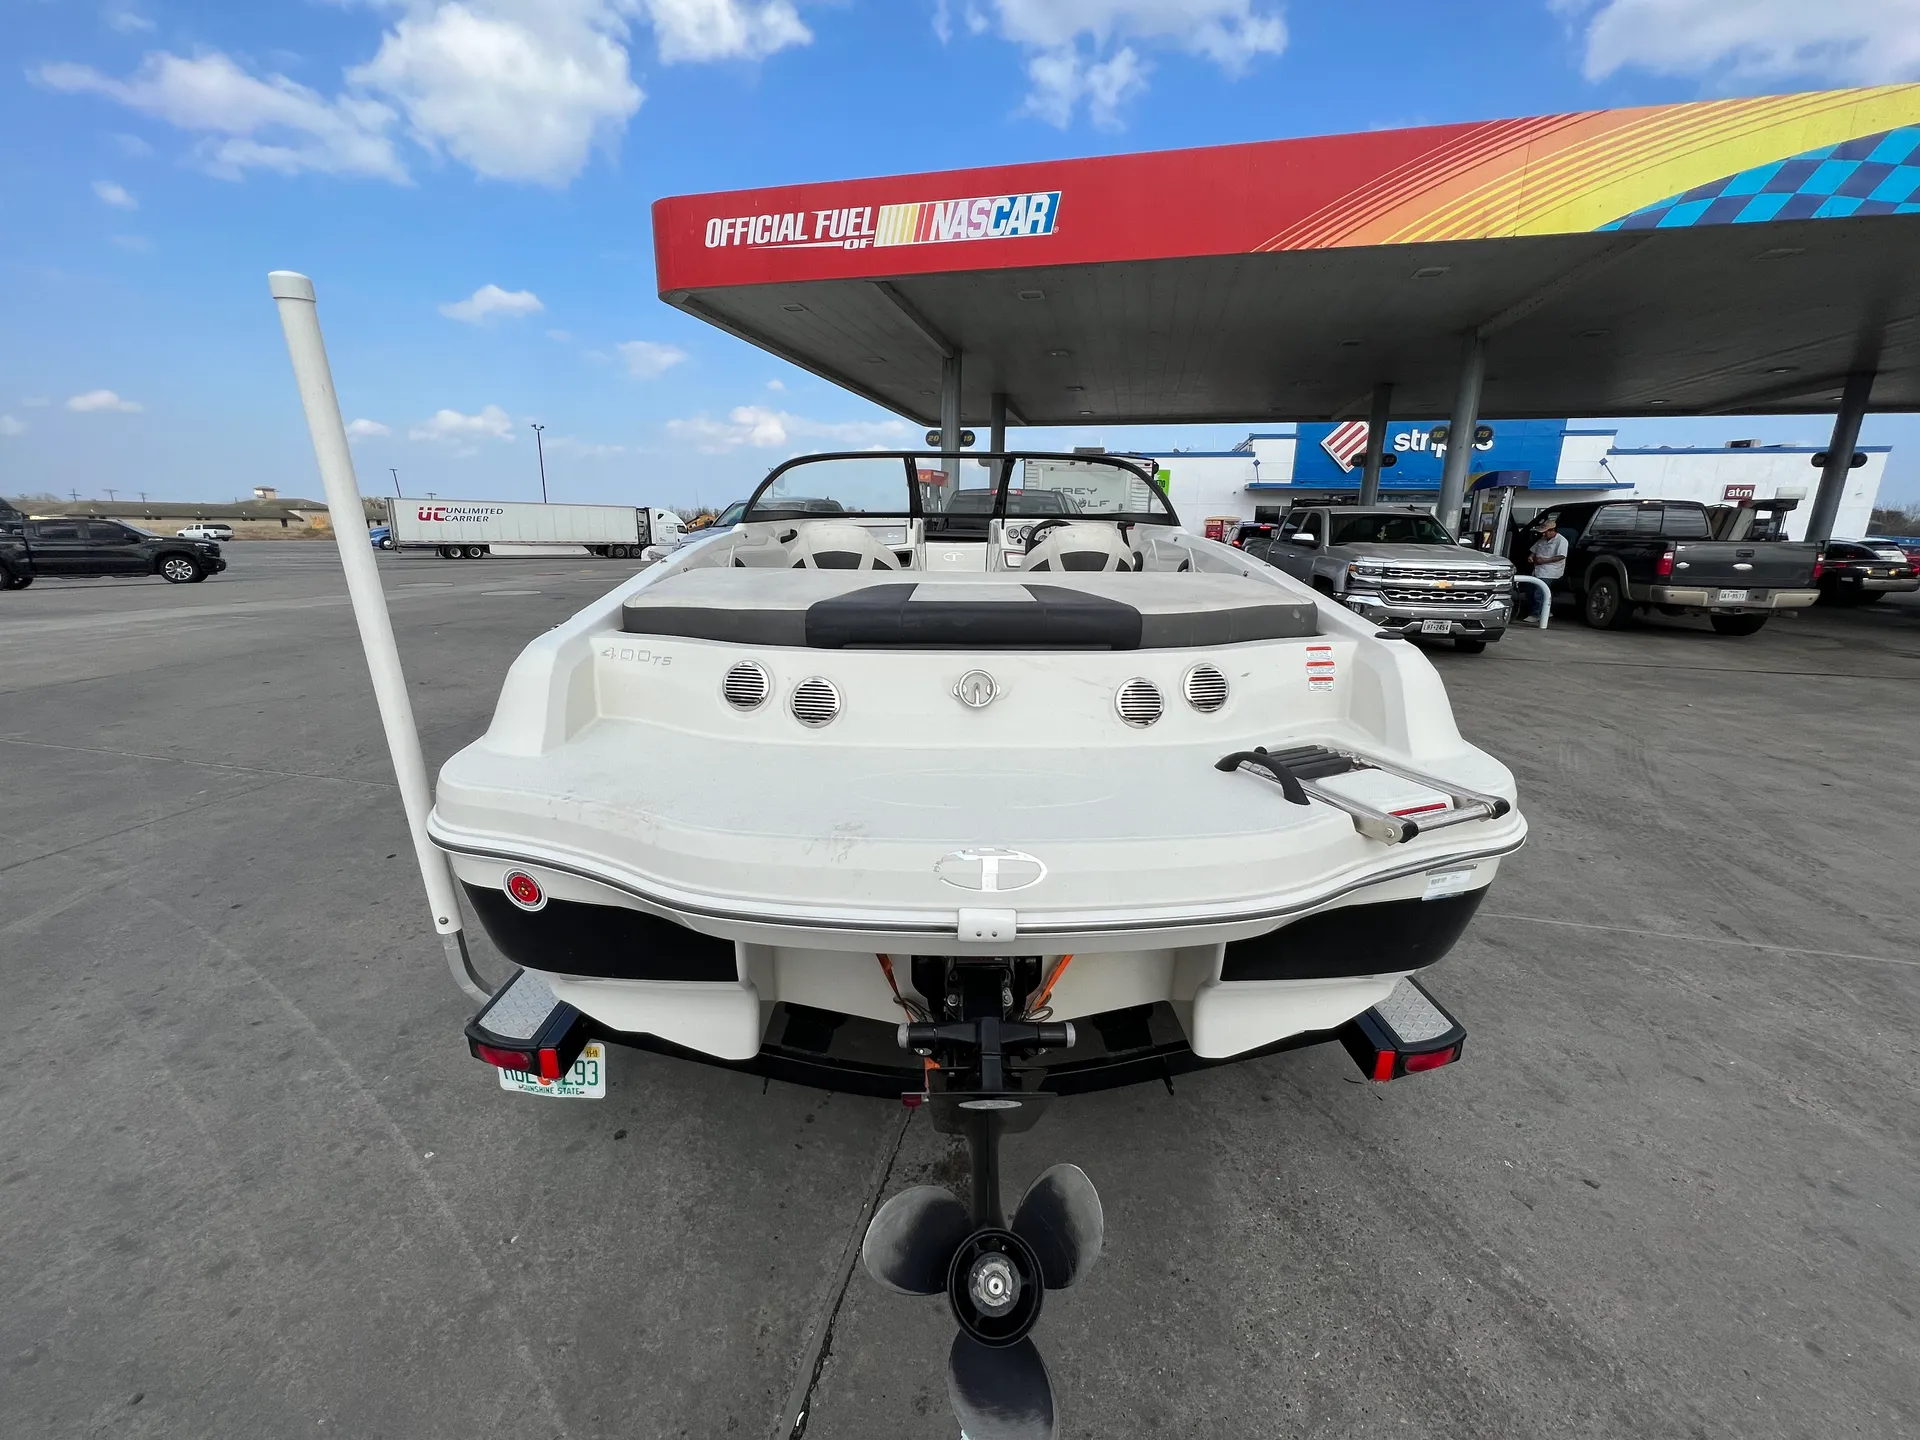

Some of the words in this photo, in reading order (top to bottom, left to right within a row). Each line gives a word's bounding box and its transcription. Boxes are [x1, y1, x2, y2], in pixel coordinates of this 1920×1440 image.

[929, 193, 1051, 240] NASCAR
[704, 212, 808, 248] OFFICIAL
[811, 206, 875, 239] FUEL
[843, 238, 873, 250] OF
[1727, 487, 1753, 498] atm
[418, 506, 446, 521] UC
[445, 507, 504, 515] UNLIMITED
[444, 514, 490, 522] CARRIER
[523, 1085, 554, 1095] SUNSHINE
[557, 1087, 580, 1096] STATE
